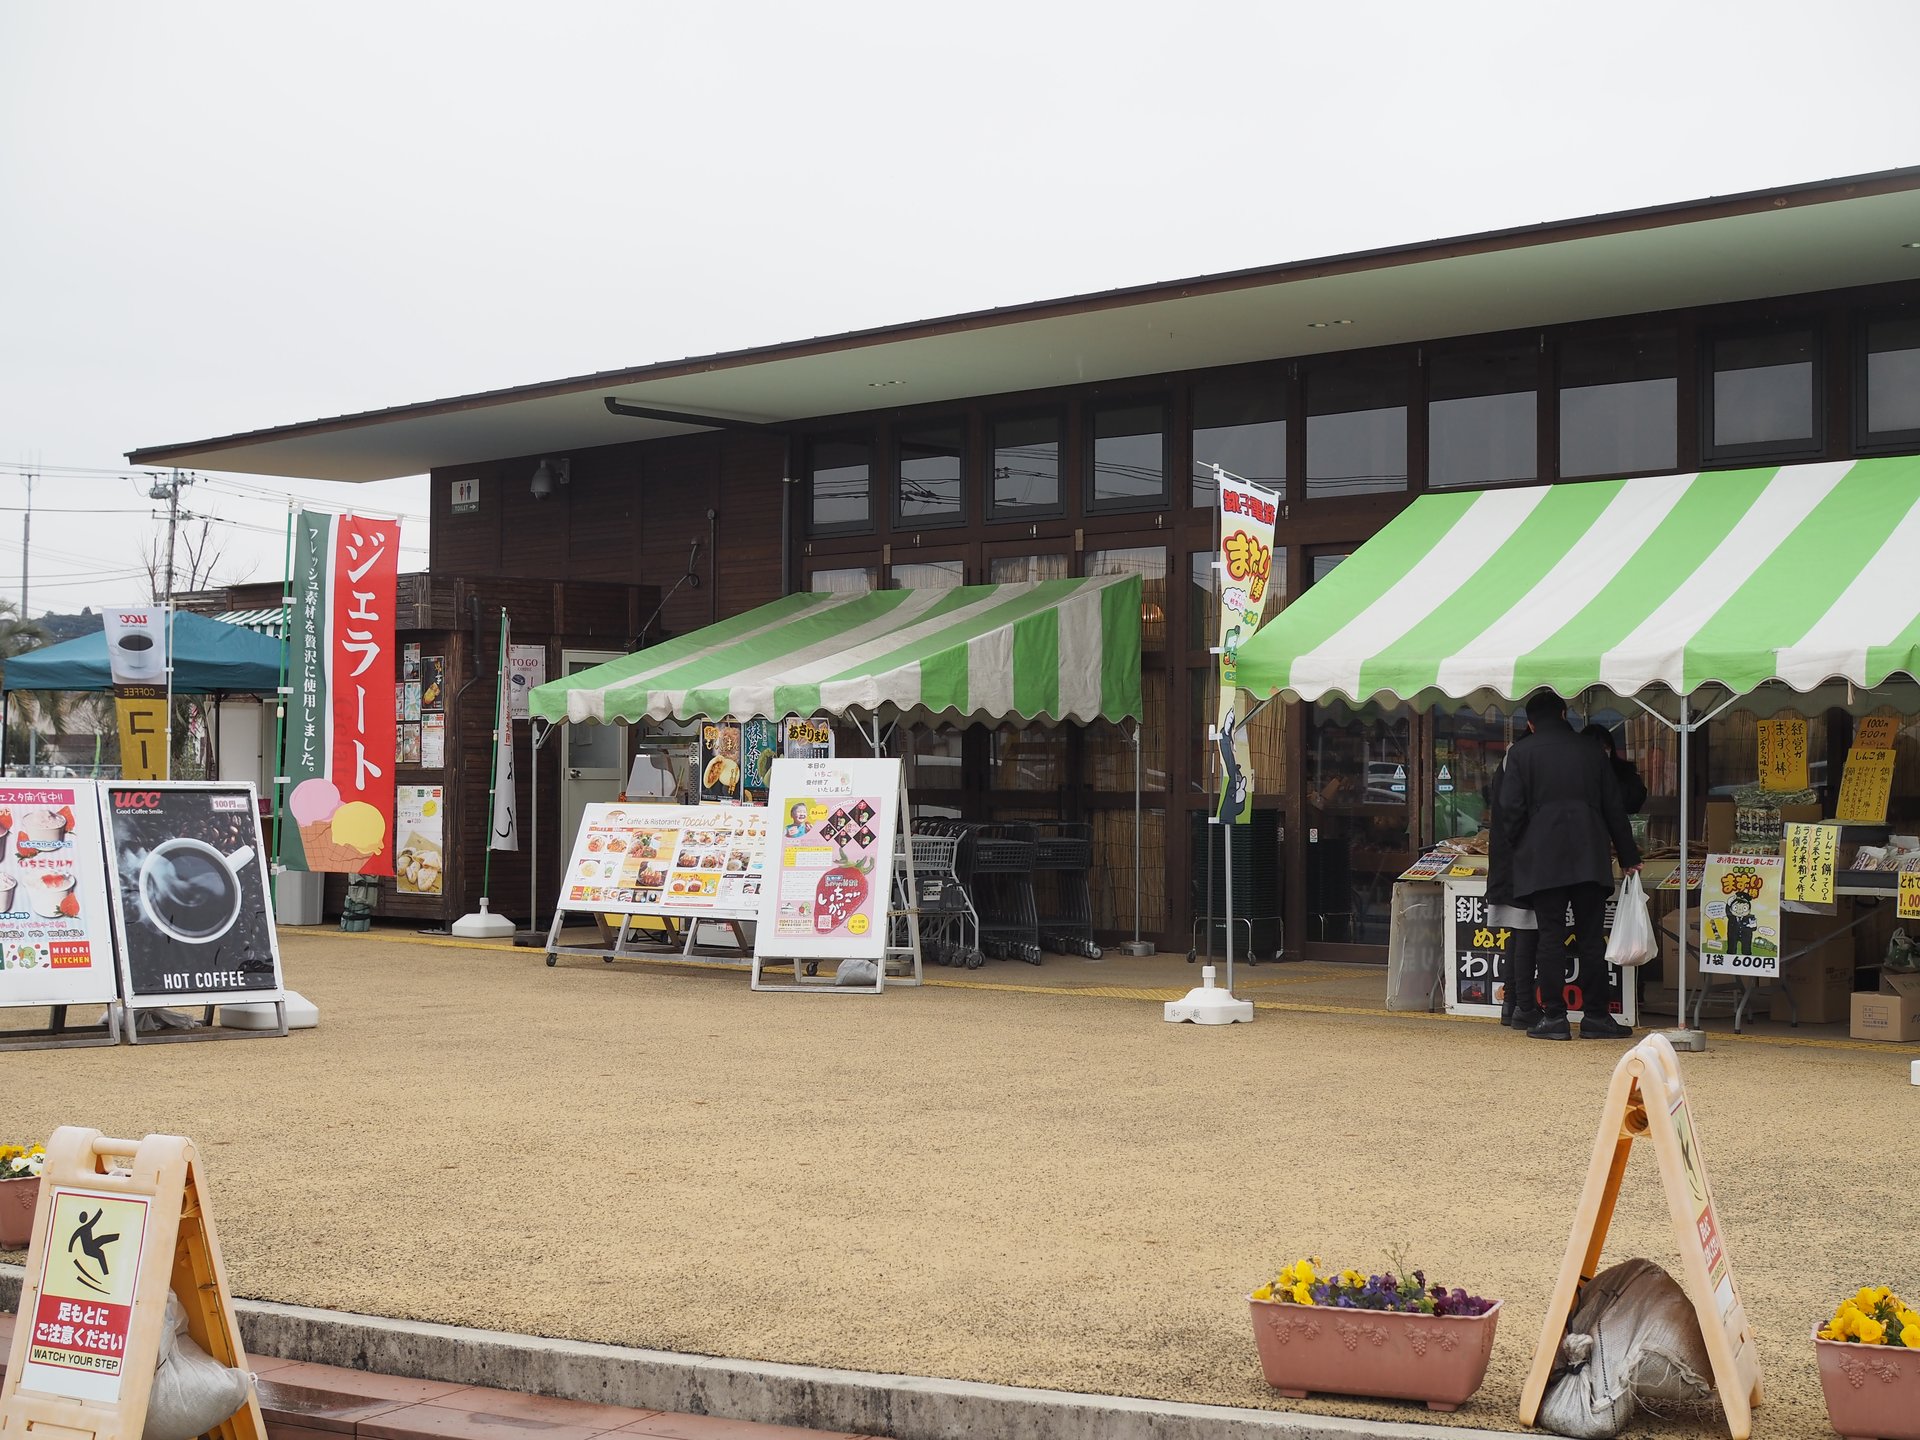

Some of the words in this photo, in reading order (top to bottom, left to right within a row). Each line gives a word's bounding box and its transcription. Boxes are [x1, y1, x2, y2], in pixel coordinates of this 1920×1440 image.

[301, 528, 319, 772] フレッシュ素材を贅沢に使用しました。
[342, 532, 385, 791] ジェラート
[511, 659, 524, 667] TO
[525, 658, 538, 667] GO
[789, 722, 829, 742] あさりまん
[747, 720, 763, 786] 抹茶まん
[1775, 721, 1787, 775] まずい棒
[1855, 751, 1886, 761] しんこ餅
[215, 800, 236, 809] 100円
[818, 886, 861, 905] いちご
[829, 903, 847, 919] がり
[52, 946, 89, 954] MINORI
[53, 956, 90, 964] KITCHEN
[1706, 954, 1724, 966] 1袋
[1732, 956, 1776, 969] 600円
[164, 973, 190, 989] HOT
[195, 971, 246, 988] COFFEE
[57, 1302, 109, 1326] 足もとに
[36, 1322, 124, 1351] ご注意ください
[33, 1348, 66, 1363] WATCH
[68, 1353, 94, 1367] YOUR
[94, 1357, 119, 1370] STEP
